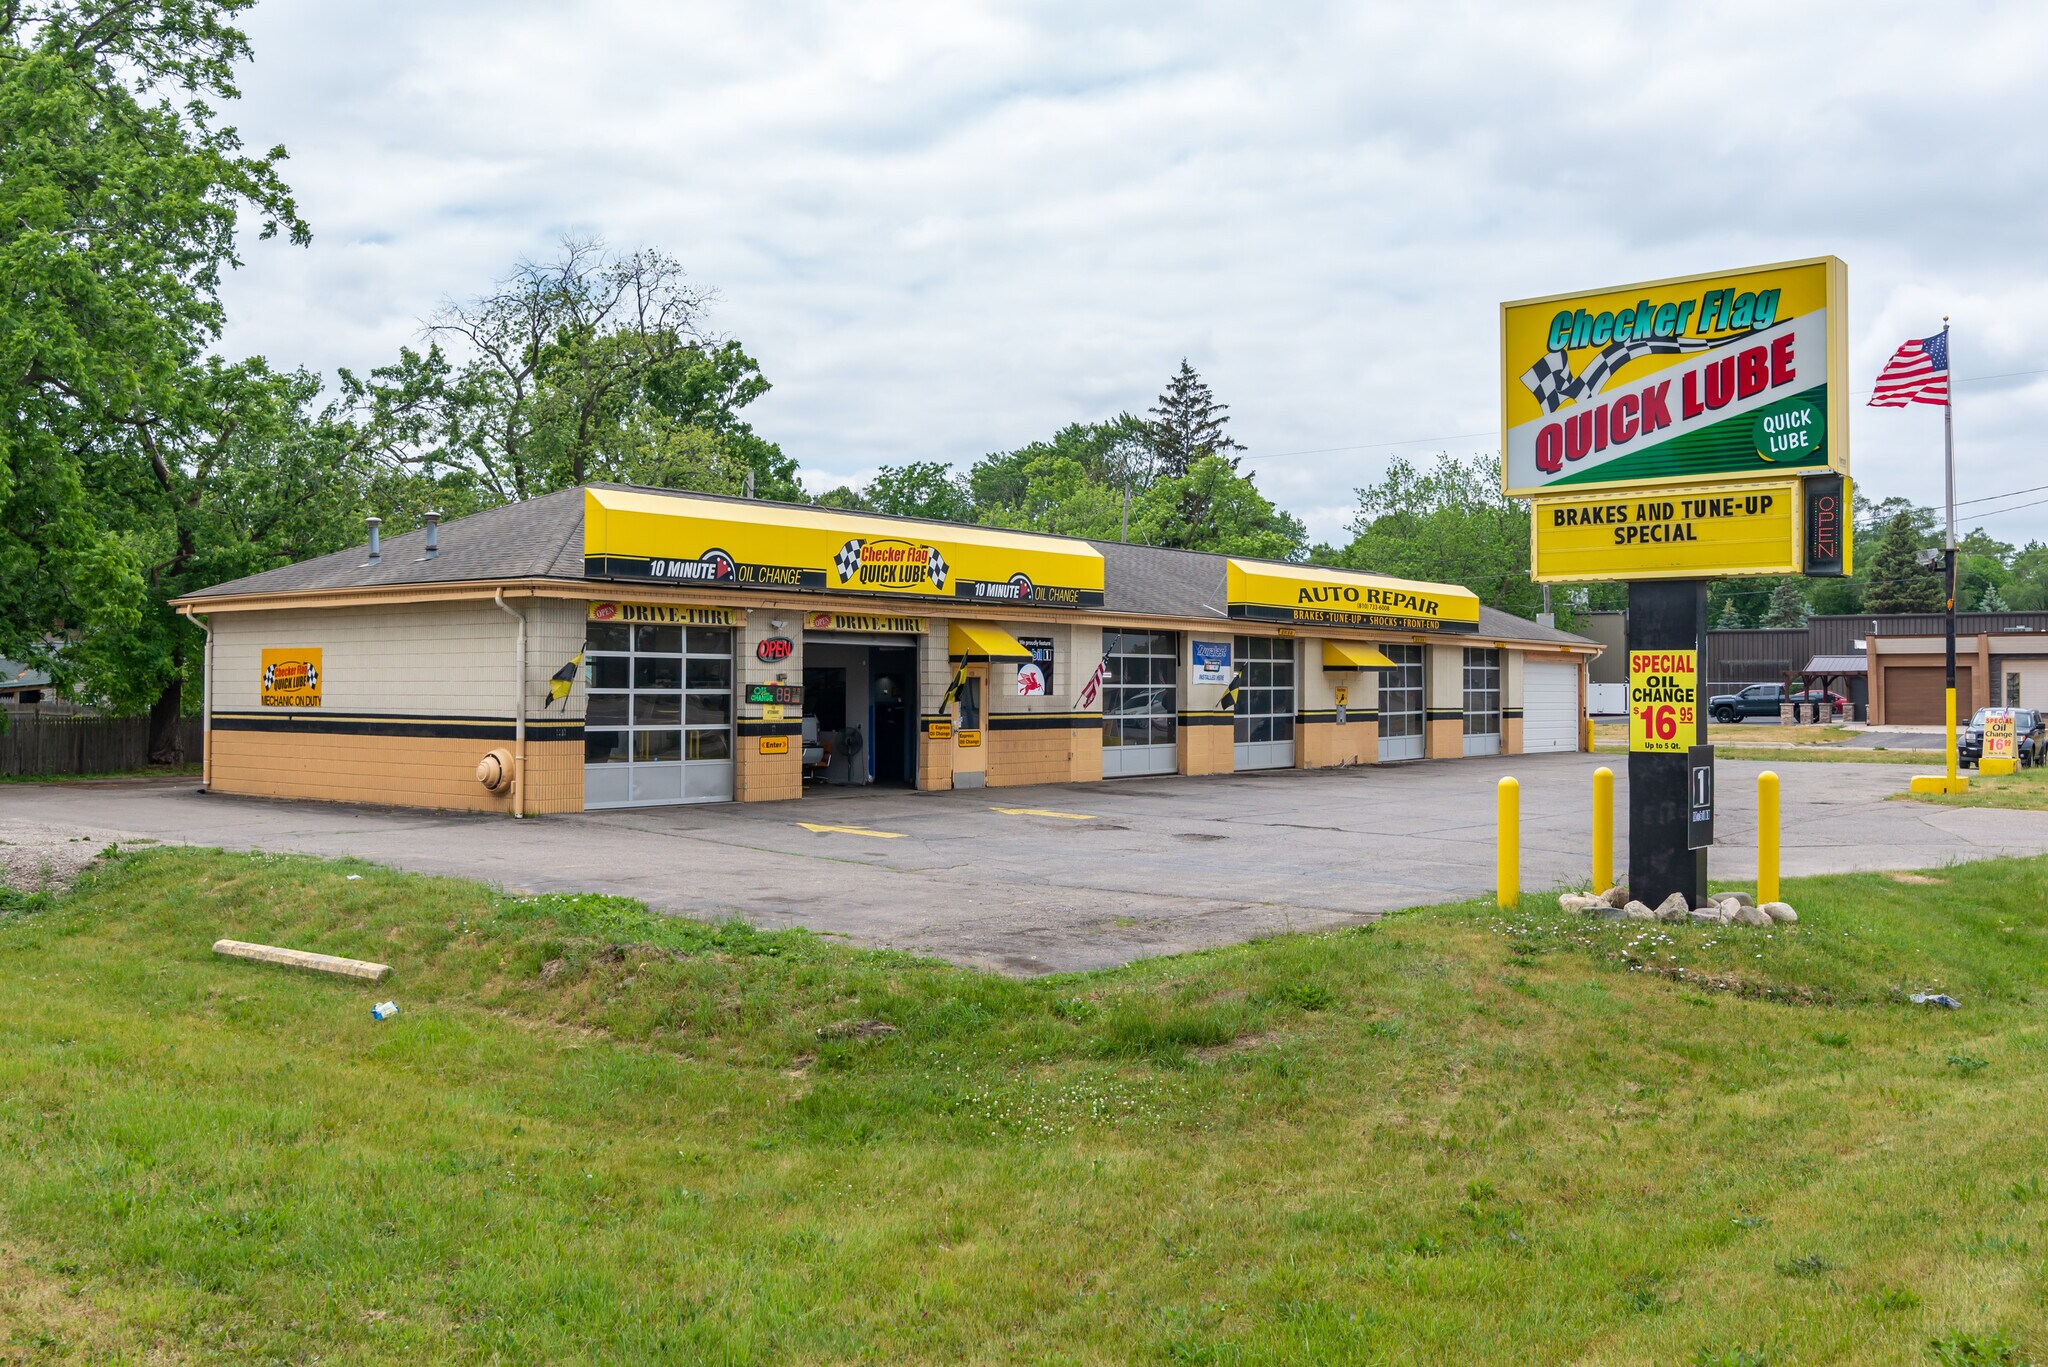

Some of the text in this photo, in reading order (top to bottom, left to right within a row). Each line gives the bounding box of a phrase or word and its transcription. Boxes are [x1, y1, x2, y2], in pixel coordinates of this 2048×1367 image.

[1548, 287, 1782, 351] Checker Flag
[1535, 332, 1797, 474] QUICK LUBE
[1763, 408, 1812, 453] QUICK LUBE
[1553, 495, 1774, 527] BRAKES AND TUNE-UP
[1613, 523, 1698, 545] SPECIAL
[1818, 496, 1835, 559] OPEN
[861, 547, 929, 564] Checker Flag
[650, 560, 717, 580] 10 MINUTE
[738, 565, 802, 585] OIL CHANGE
[859, 564, 927, 585] QUICK LUBE
[975, 583, 1020, 599] 10 MINUTE
[1034, 587, 1079, 603] OIL CHANGE
[1298, 586, 1440, 616] AUTO REPAIR
[596, 605, 736, 625] OPEN DRIVE-THRU
[835, 615, 922, 631] DRIVE-THRU
[1293, 610, 1324, 621] BRAKES
[1369, 616, 1398, 627] SHOCKS
[1403, 619, 1440, 629] FRONT-END
[759, 640, 791, 658] OPEN
[1197, 645, 1227, 658] Duralast
[1632, 654, 1695, 673] SPECIAL
[274, 675, 307, 691] QUICK LUBE
[1646, 675, 1680, 688] OIL
[262, 695, 322, 707] MECHANIC ON DUTY
[1632, 688, 1695, 703] CHANGE
[1645, 742, 1654, 750] Up
